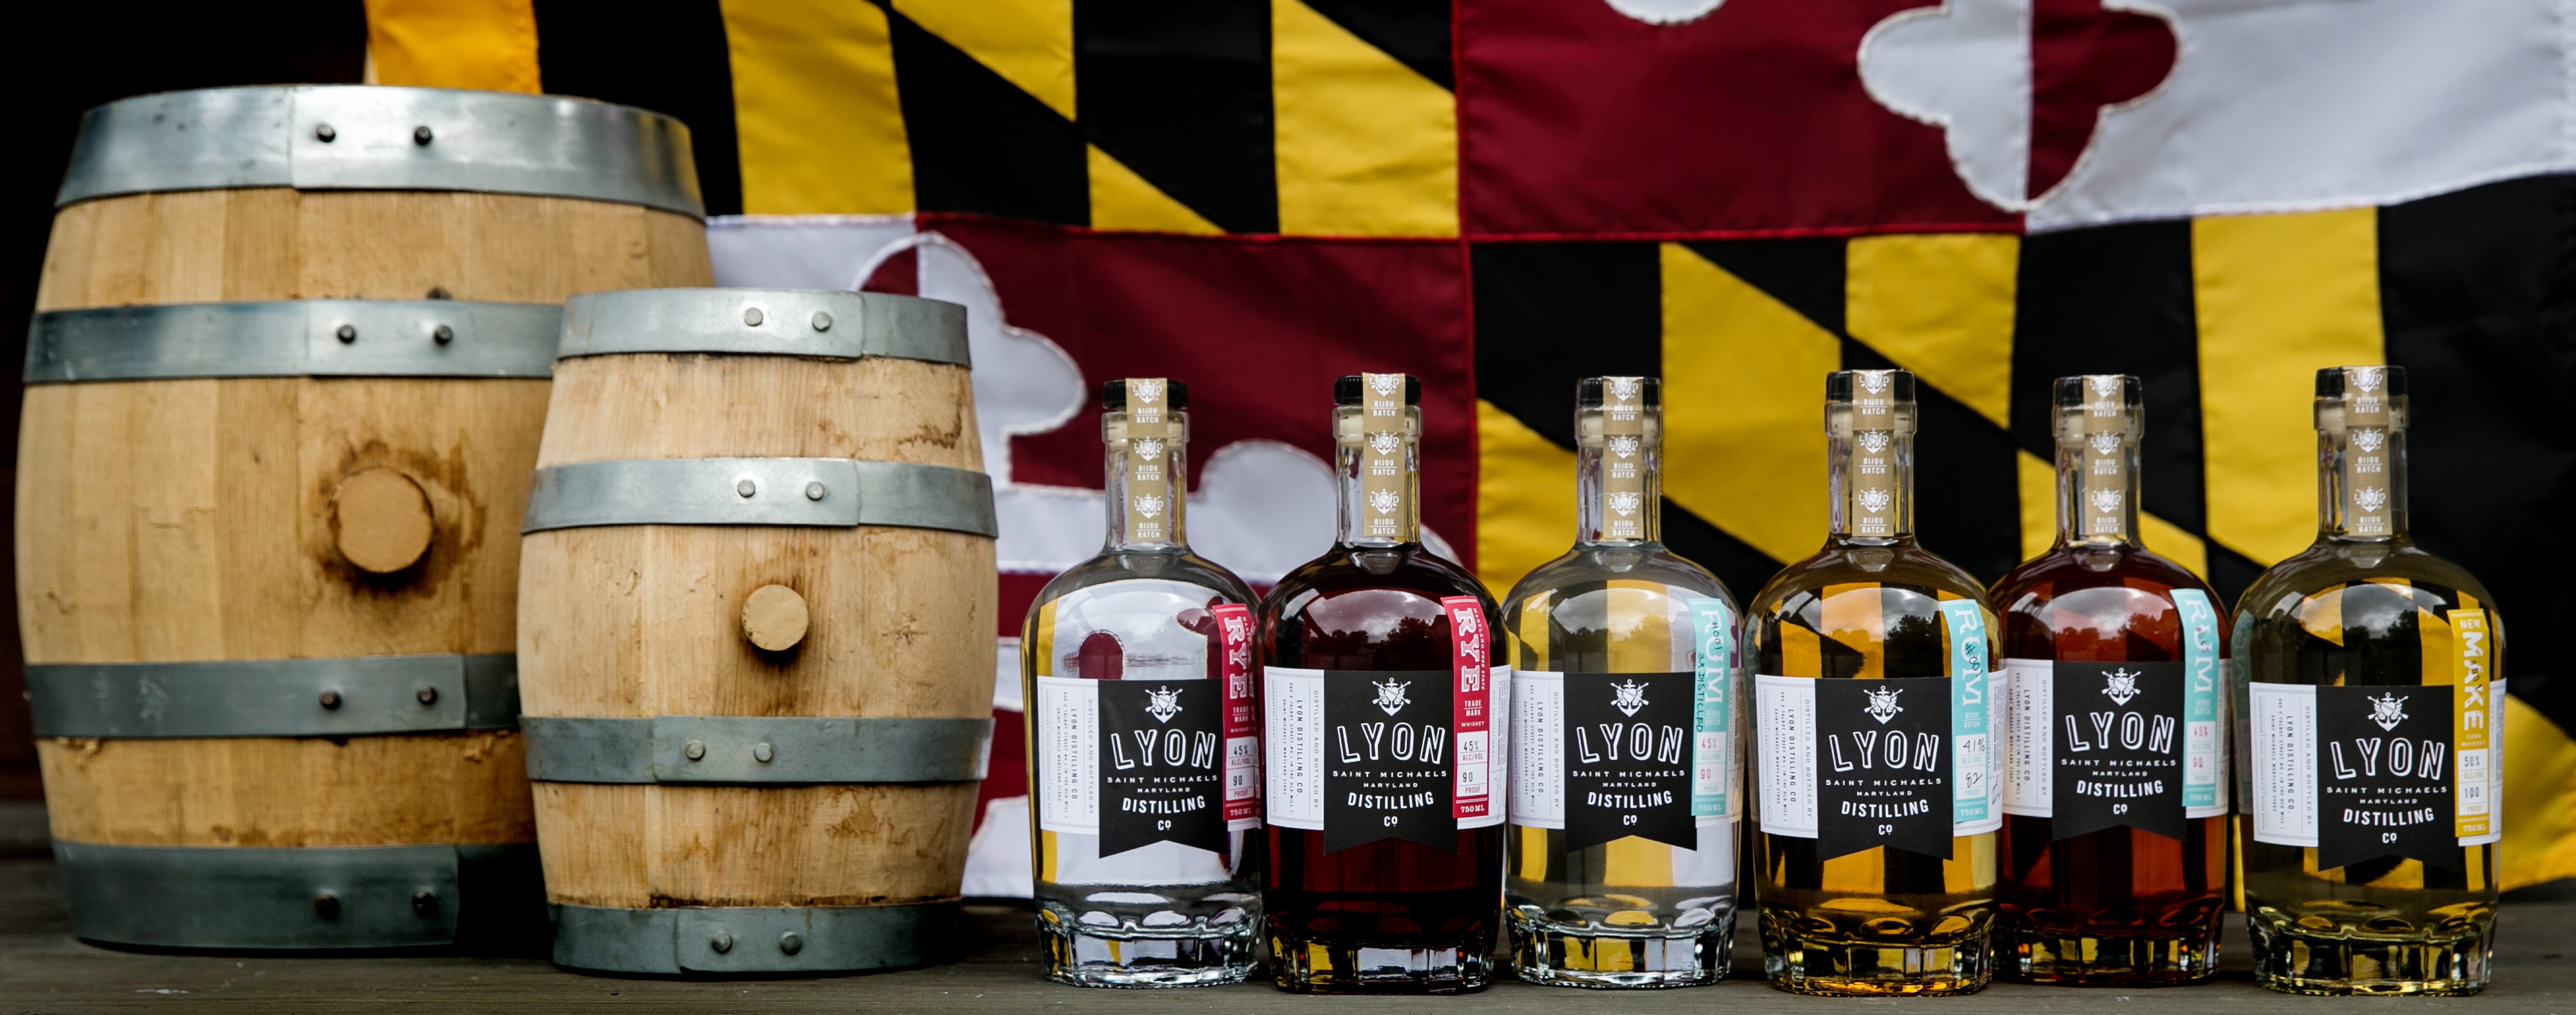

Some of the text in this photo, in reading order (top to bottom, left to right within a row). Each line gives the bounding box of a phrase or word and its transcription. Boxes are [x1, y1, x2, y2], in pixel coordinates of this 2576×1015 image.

[1473, 608, 1485, 649] MARYLAND
[2460, 619, 2481, 629] NEW
[1454, 608, 1480, 693] RYE
[2185, 599, 2213, 693] RUM
[1225, 616, 1247, 699] RYE
[1698, 653, 1704, 668] 3X
[1701, 609, 1724, 703] RUM
[1955, 608, 1981, 706] RUM
[2462, 632, 2484, 731] MAKE
[2066, 712, 2175, 753] LYON
[2193, 726, 2208, 737] 45%
[1111, 729, 1216, 770] LYON
[1234, 745, 1248, 756] 45%
[1337, 722, 1445, 764] LYON
[1464, 740, 1478, 751] 45%
[1576, 723, 1683, 764] LYON
[1701, 738, 1716, 748] 45%
[1829, 730, 1939, 772] LYON
[1963, 739, 1985, 753] 41%
[2330, 737, 2445, 780] LYON
[2465, 755, 2479, 768] 50%
[1233, 775, 1243, 786] 90
[1463, 772, 1473, 782] 90
[1701, 769, 1711, 779] 90
[1966, 773, 1983, 788] 82
[2076, 780, 2163, 797] DISTILLING
[2465, 788, 2479, 798] 100
[1122, 796, 1205, 814] DISTILLING
[1313, 799, 1318, 809] BY
[1348, 791, 1434, 809] DISTILLING
[1588, 791, 1672, 808] DISTILLING
[1807, 808, 1811, 818] BY
[1842, 800, 1929, 818] DISTILLING
[2343, 807, 2434, 826] DISTILLING
